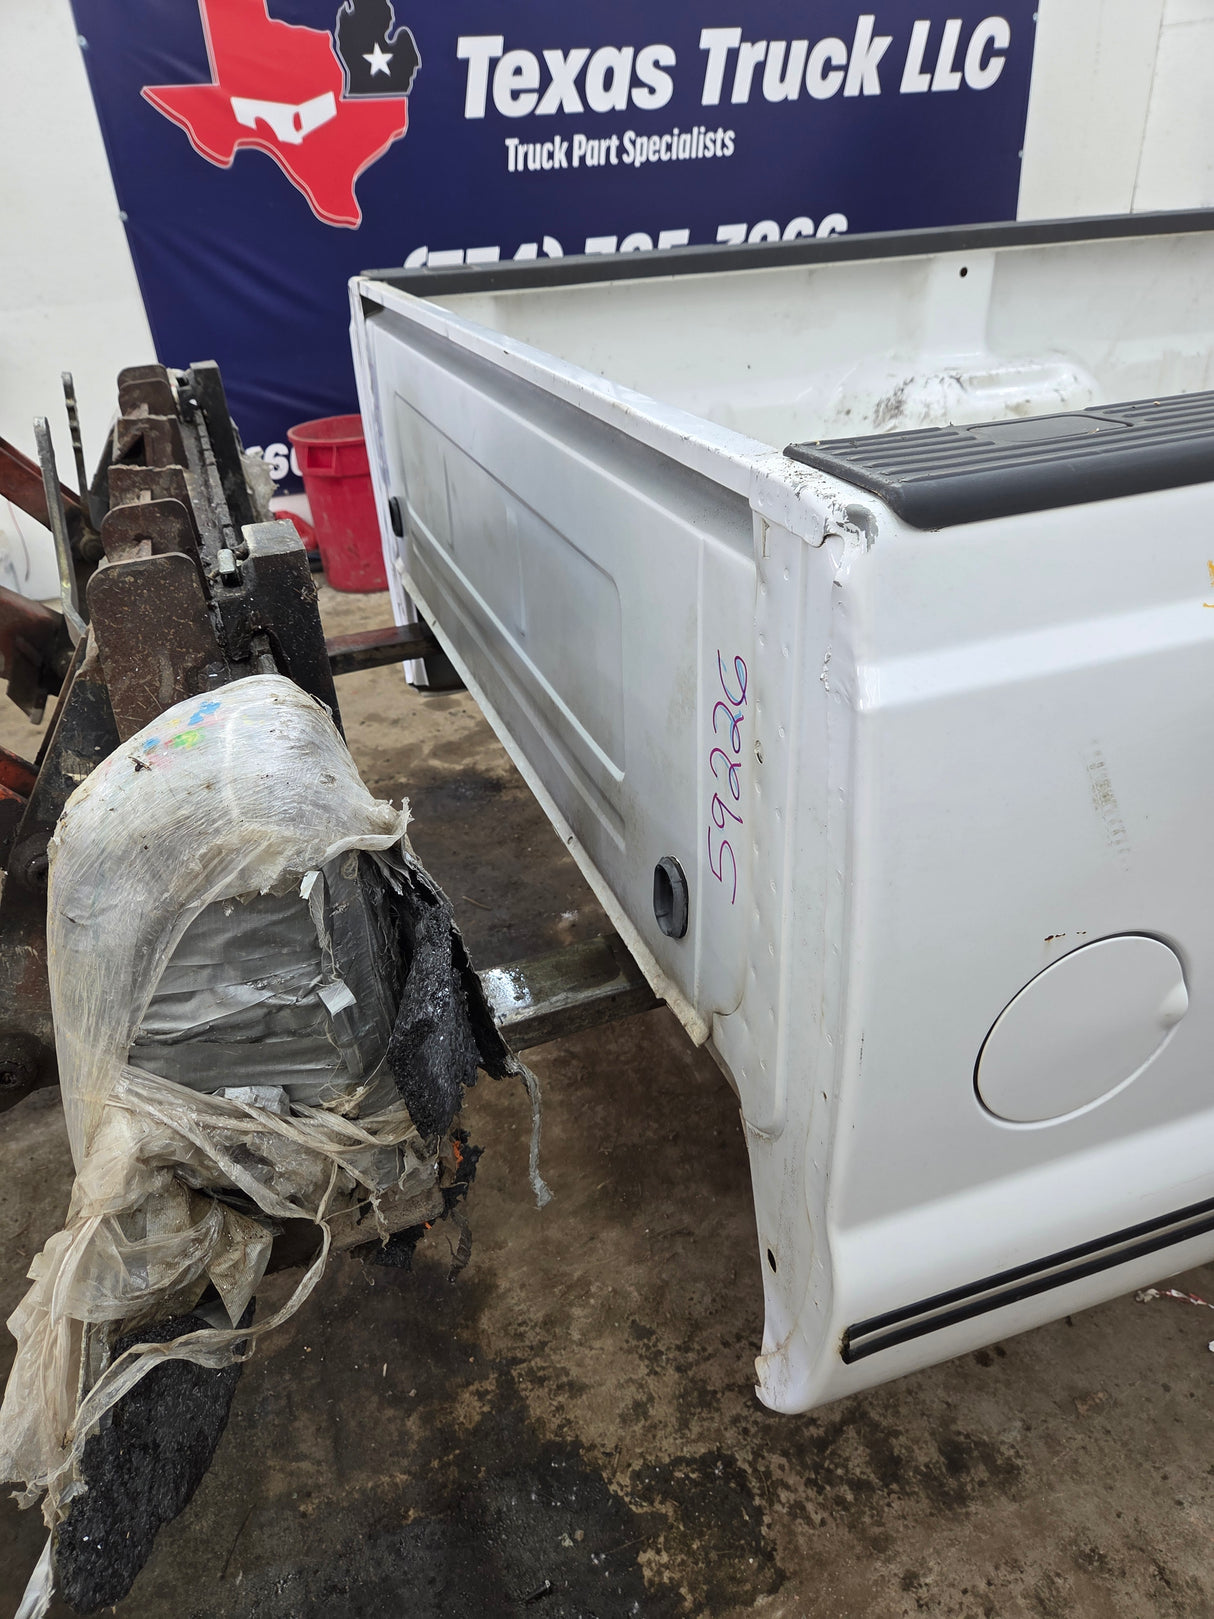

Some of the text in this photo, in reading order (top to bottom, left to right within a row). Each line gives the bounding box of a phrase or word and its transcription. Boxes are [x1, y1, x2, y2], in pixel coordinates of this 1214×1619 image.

[456, 14, 1011, 120] Texas Truck LLC
[505, 126, 736, 173] Truck Part Specialists
[707, 649, 749, 905] 59226
